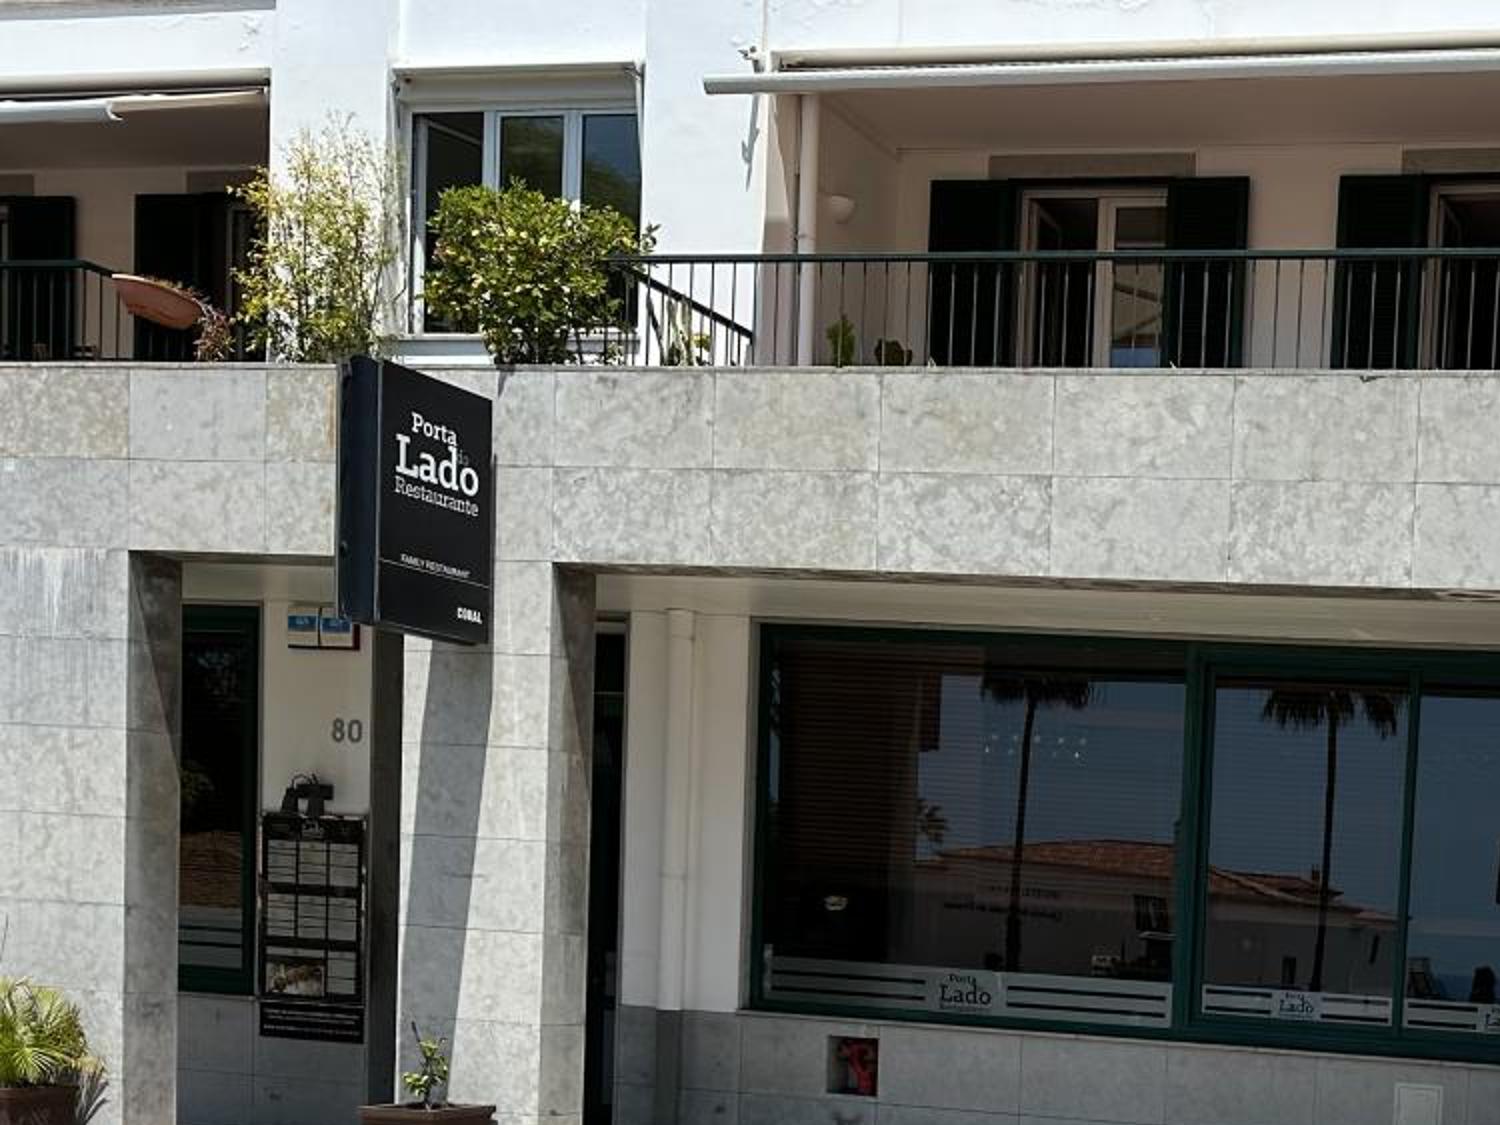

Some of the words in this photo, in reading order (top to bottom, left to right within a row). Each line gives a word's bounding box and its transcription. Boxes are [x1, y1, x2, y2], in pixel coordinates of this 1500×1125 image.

[411, 411, 458, 446] Porta
[395, 432, 480, 497] Lado
[394, 475, 479, 517] Restaurante
[332, 717, 363, 744] 80
[940, 983, 992, 1005] Lado
